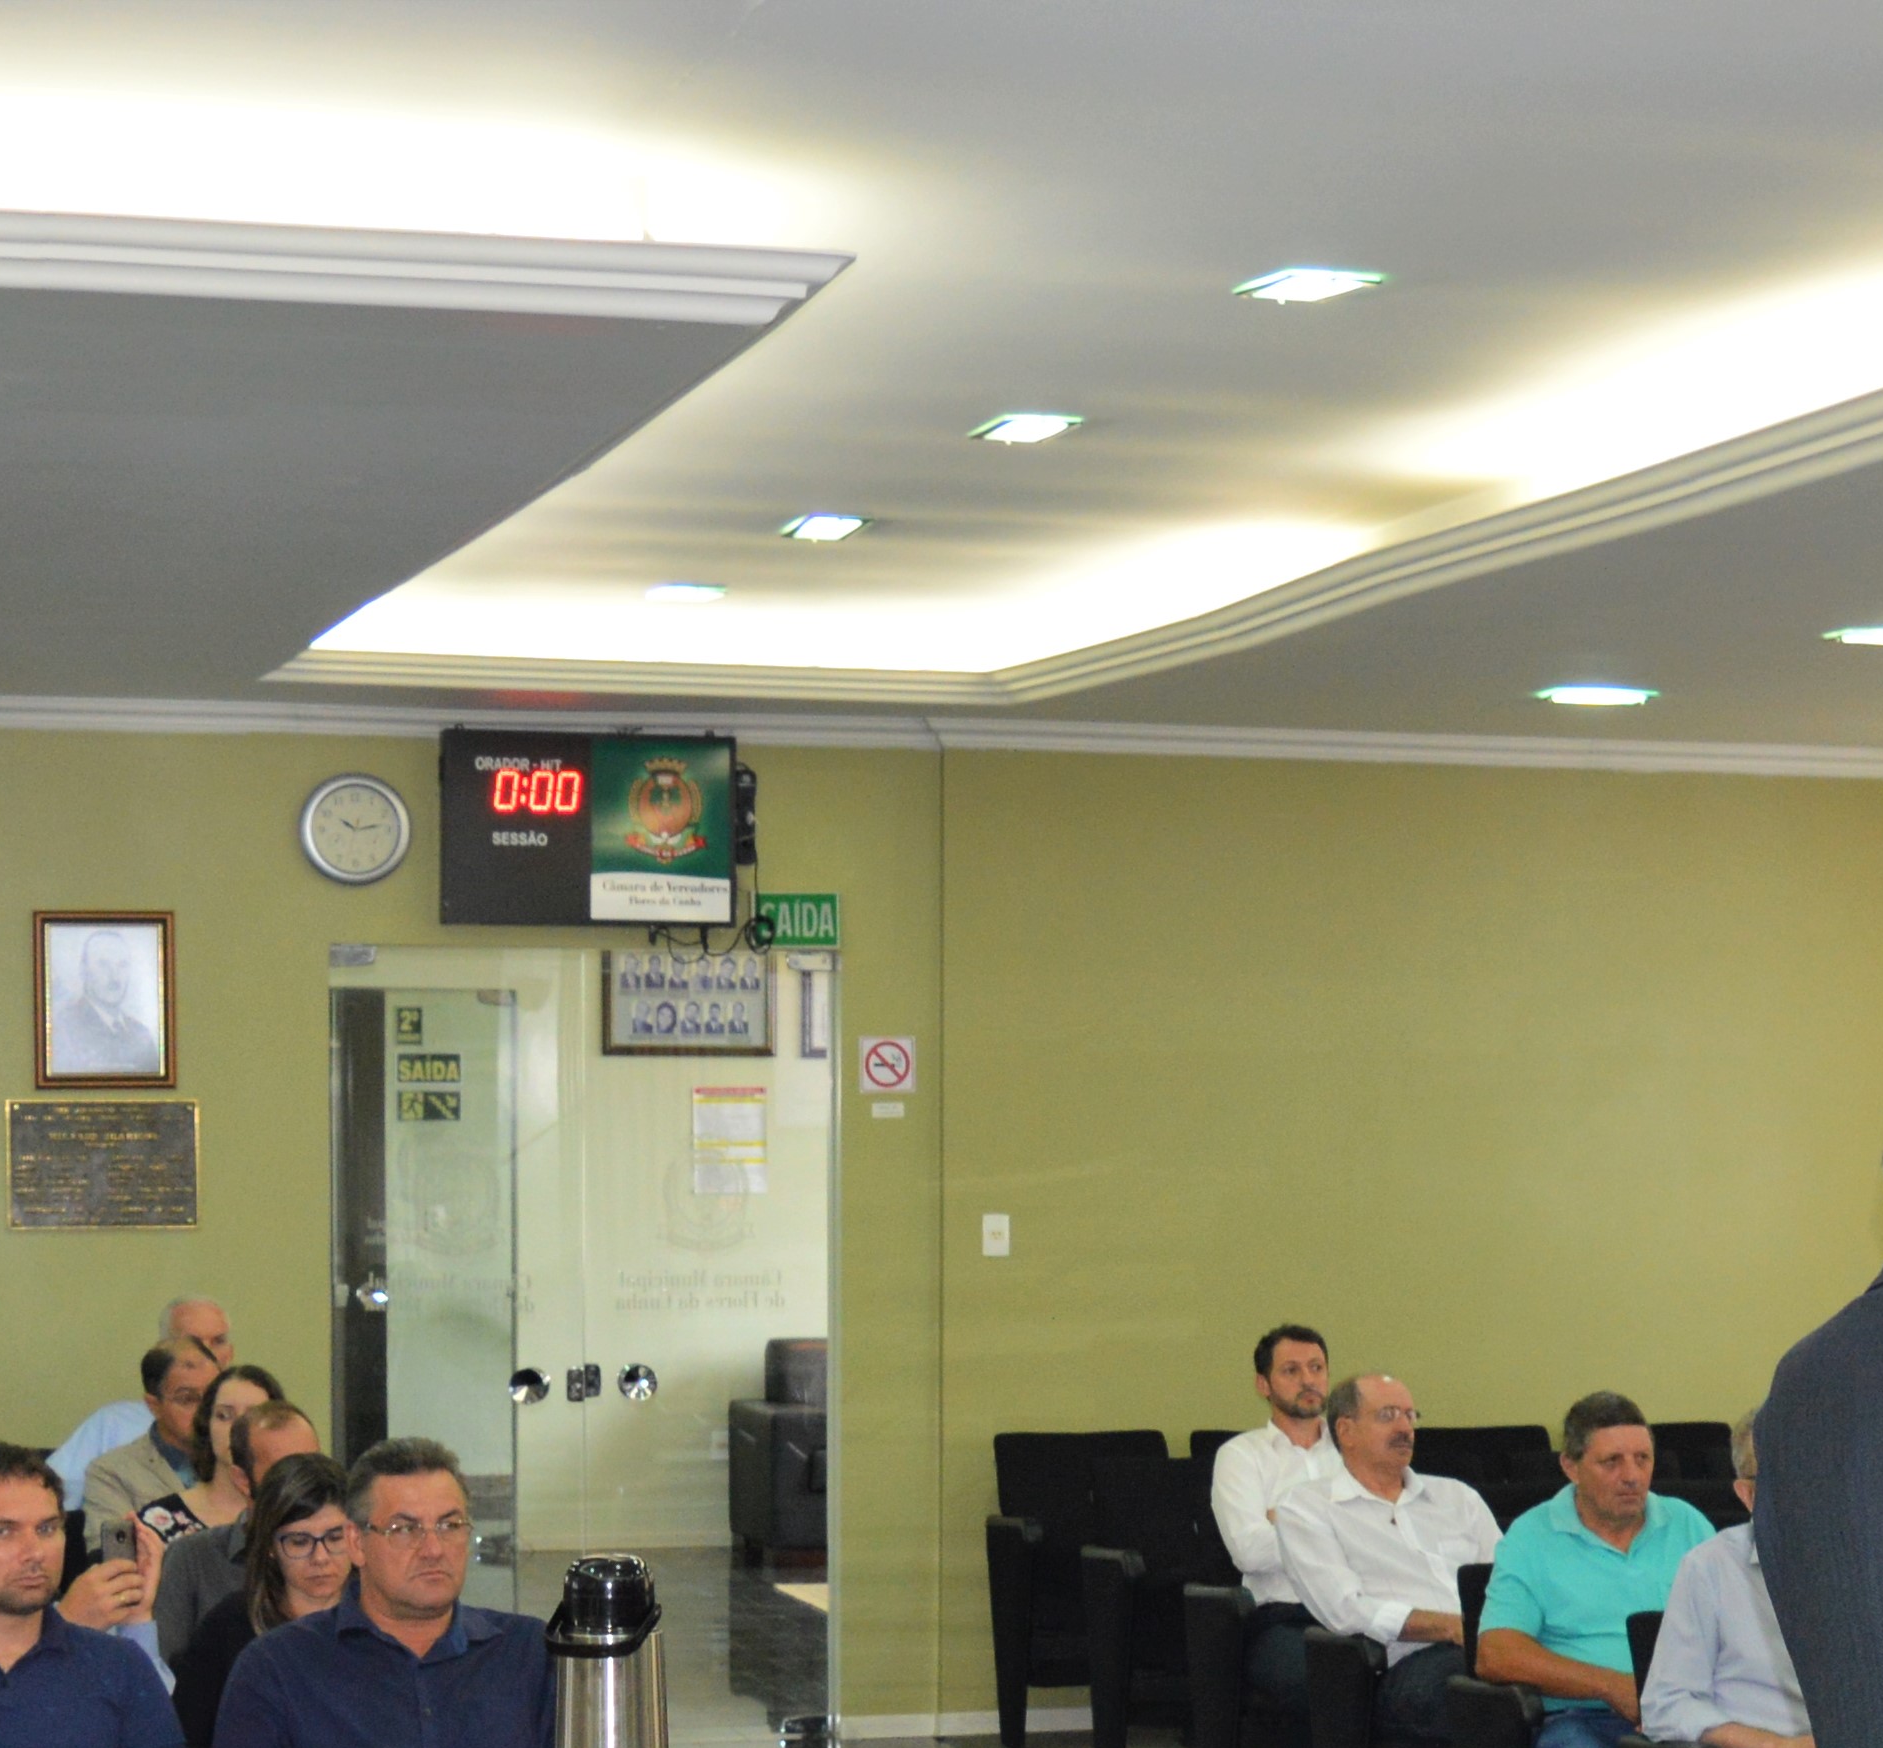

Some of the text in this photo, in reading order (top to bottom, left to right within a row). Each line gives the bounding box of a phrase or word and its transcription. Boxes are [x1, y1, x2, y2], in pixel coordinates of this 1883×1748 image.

[493, 769, 581, 812] 0:00
[491, 829, 549, 847] SESSÃO
[650, 880, 664, 892] de
[760, 900, 834, 938] SAÍDA
